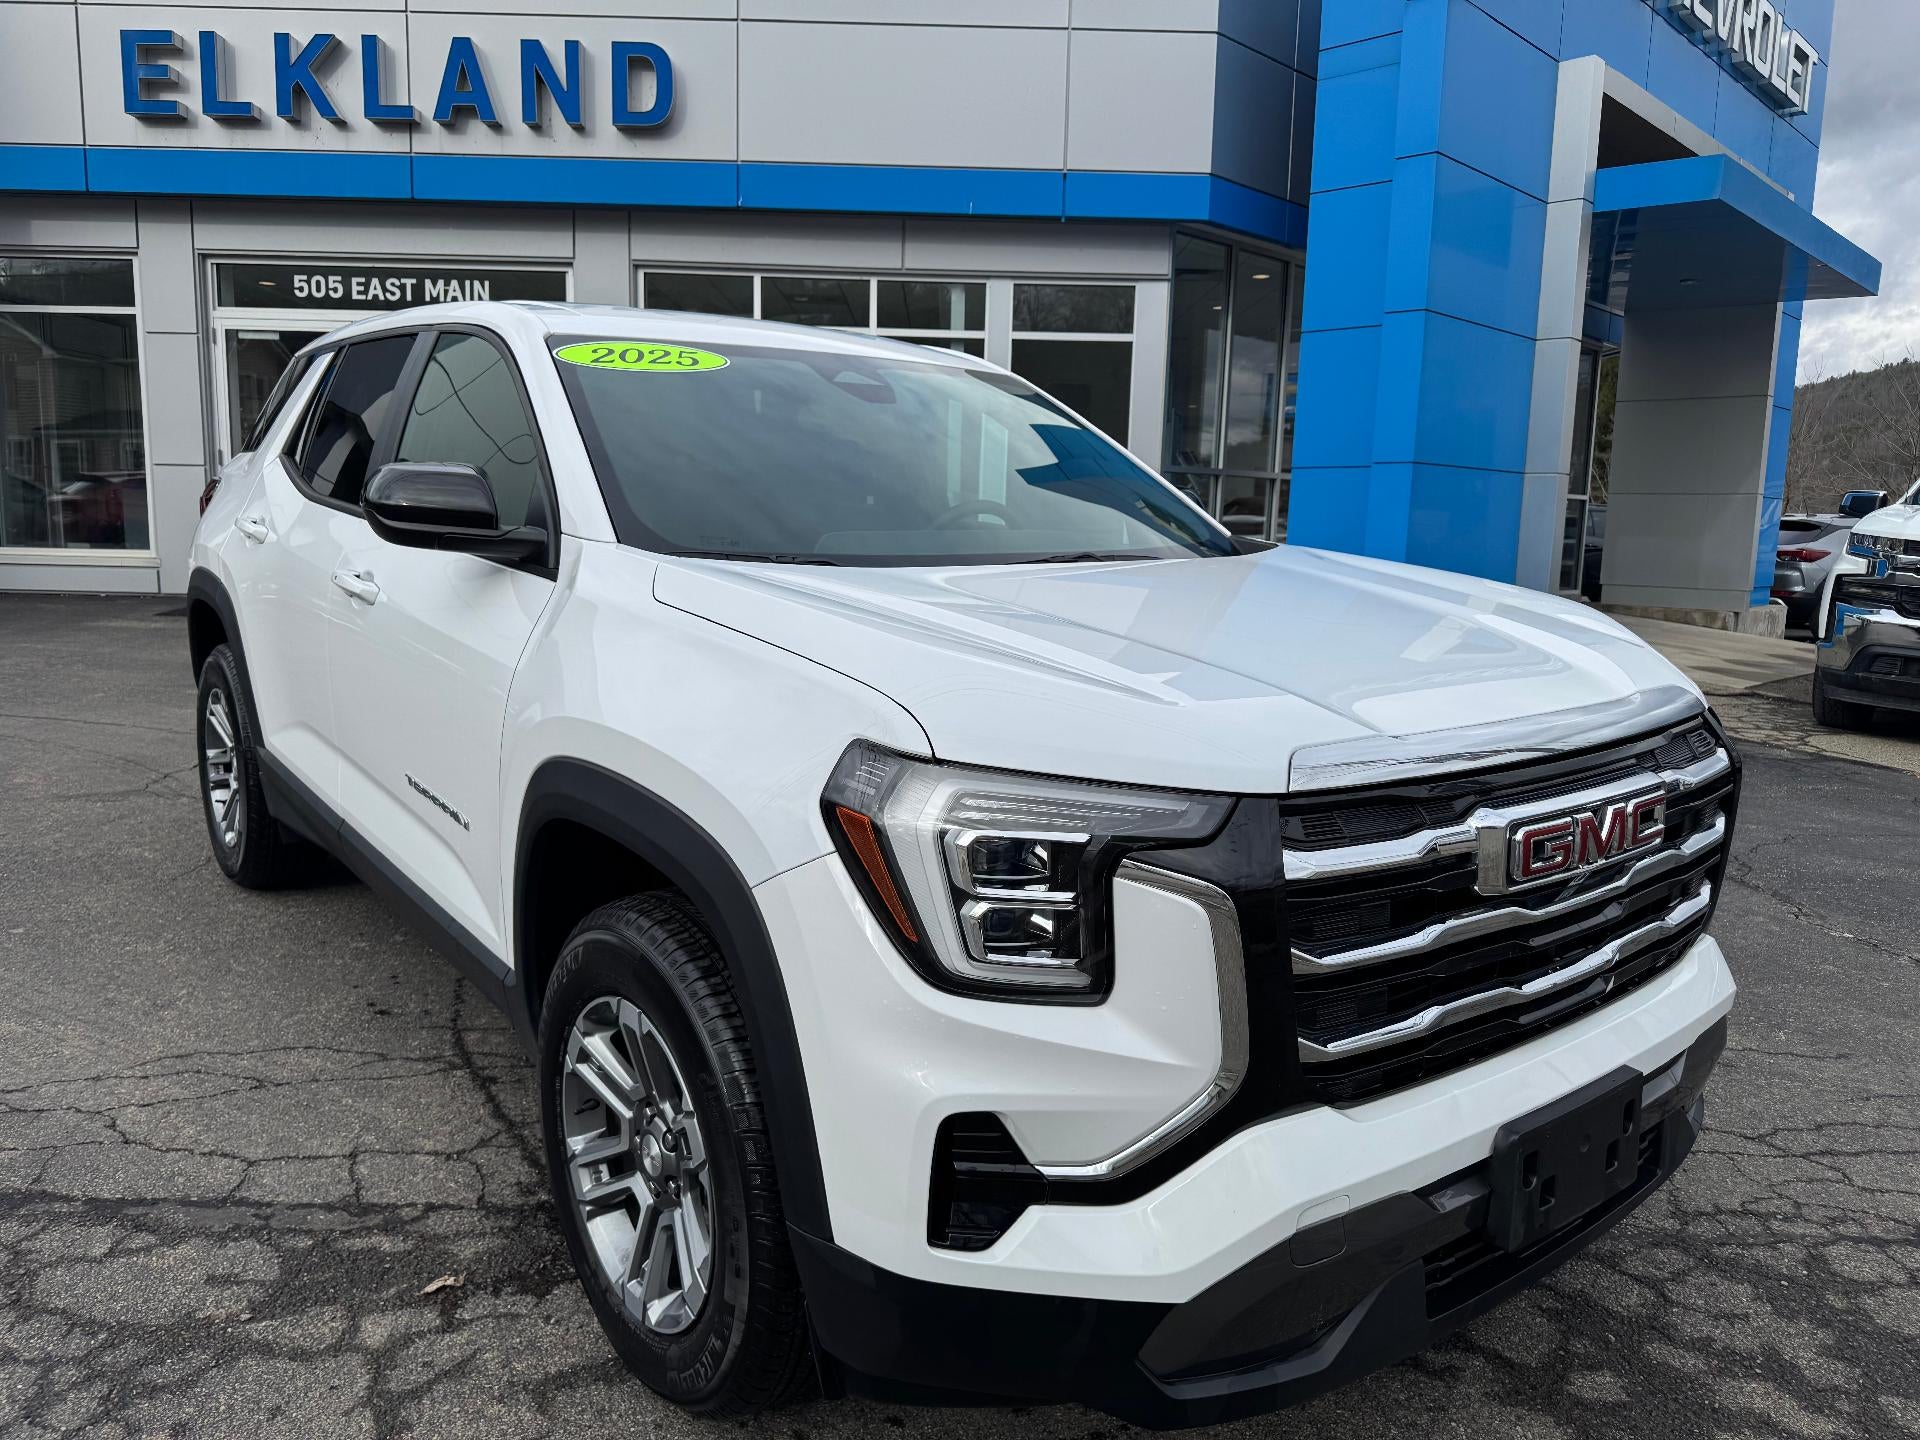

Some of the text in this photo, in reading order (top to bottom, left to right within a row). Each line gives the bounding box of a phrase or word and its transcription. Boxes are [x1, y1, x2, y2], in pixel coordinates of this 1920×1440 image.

[119, 29, 677, 130] ELKLAND
[293, 274, 490, 302] 505 EAST MAIN
[590, 347, 700, 367] 2025
[1512, 790, 1666, 881] GMC
